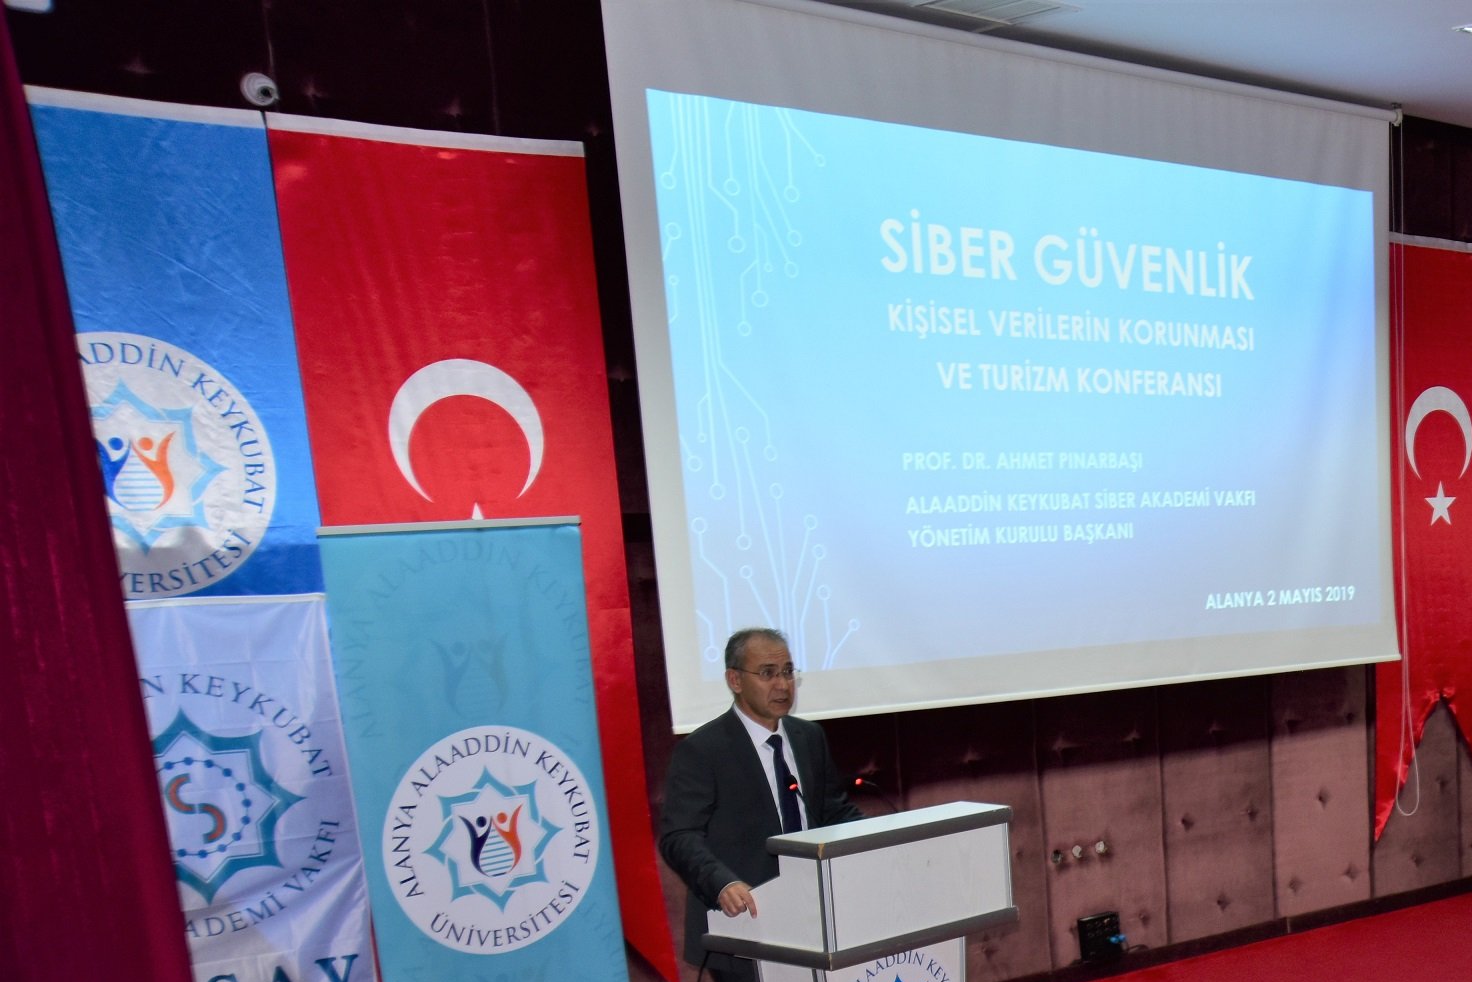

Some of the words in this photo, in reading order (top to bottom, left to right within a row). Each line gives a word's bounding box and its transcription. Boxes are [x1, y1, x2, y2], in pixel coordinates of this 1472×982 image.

[880, 208, 1018, 281] SİBER
[1033, 226, 1255, 300] GÜVENLİK
[888, 298, 981, 339] KİŞİSEL
[988, 306, 1110, 342] VERİLERİN
[1119, 318, 1254, 351] KORUNMASI
[936, 361, 972, 390] VE
[979, 359, 1069, 393] TURİZM
[1077, 367, 1222, 398] KONFERANSI
[191, 373, 267, 513] KEYKUBAT
[903, 452, 956, 471] PROF.
[962, 452, 991, 471] DR.
[996, 452, 1054, 471] AHMET
[1059, 452, 1143, 472] PINARBAŞI
[906, 490, 1001, 515] ALAADDİN
[1007, 492, 1091, 512] KEYKUBAT
[1095, 488, 1136, 509] SİBER
[1140, 487, 1210, 508] AKADEMİ
[1213, 490, 1256, 507] VAKFI
[907, 524, 990, 548] YÖNETİM
[995, 526, 1058, 545] KURULU
[1063, 522, 1134, 545] BAŞKANI
[1205, 591, 1264, 610] ALANYA
[1267, 590, 1276, 605] 2
[1279, 587, 1322, 605] MAYIS
[1325, 585, 1355, 602] 2019
[180, 673, 333, 777] KEYKUBAT
[391, 803, 425, 898] ALANYA
[410, 732, 531, 797] ALAADDİN
[535, 750, 591, 864] KEYKUBAT
[283, 818, 340, 893] VAKFI
[184, 891, 287, 938] ADEMİ
[430, 879, 580, 947] ÜNİVERSİTESİ
